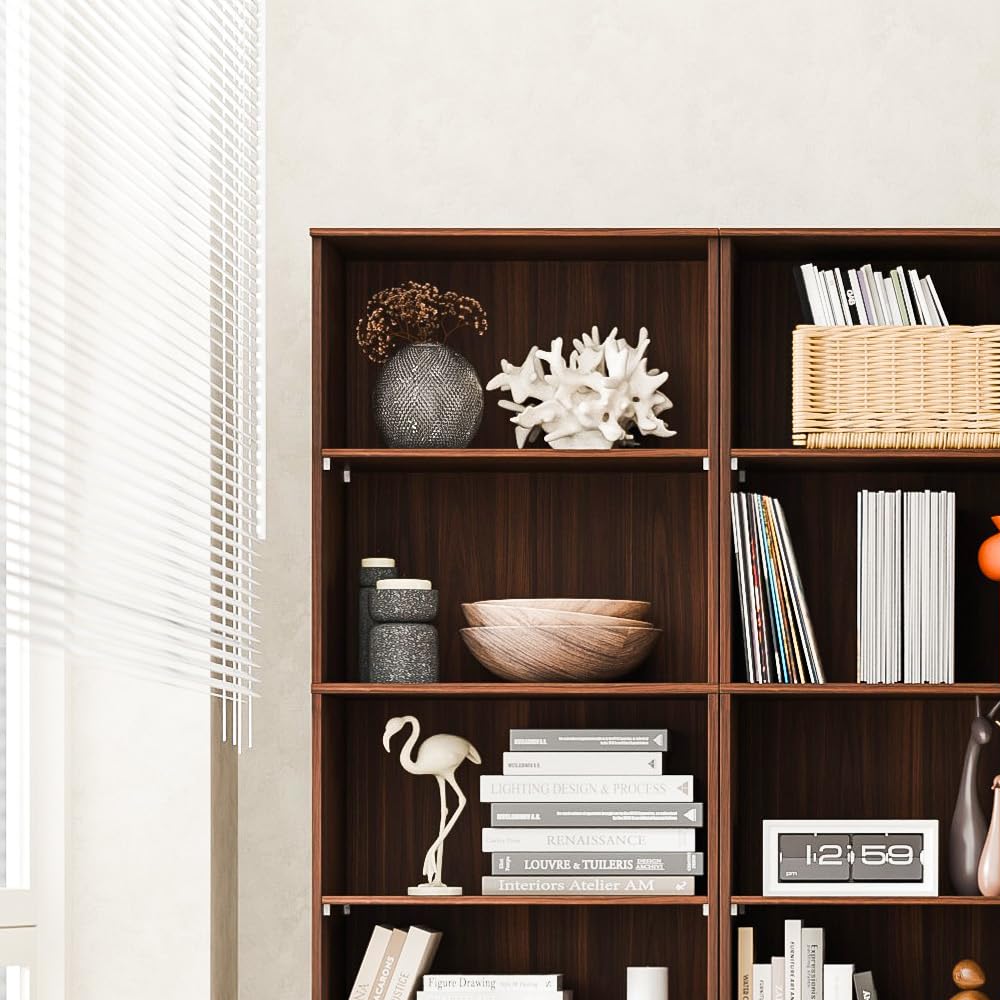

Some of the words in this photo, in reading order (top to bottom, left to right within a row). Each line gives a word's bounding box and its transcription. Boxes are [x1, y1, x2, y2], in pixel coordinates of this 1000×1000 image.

[490, 783, 550, 796] LIGHTING
[552, 783, 597, 796] DESIGN
[601, 784, 610, 795] &
[613, 783, 667, 795] PROCESS
[546, 834, 647, 846] RENAISSANCE
[524, 859, 571, 870] LOUVRE
[573, 862, 580, 870] &
[582, 859, 634, 870] TUILERIS
[499, 879, 565, 891] Interiors
[568, 879, 620, 891] Atelier
[624, 879, 655, 891] AM
[428, 977, 457, 989] Figure
[459, 977, 496, 989] Drawing
